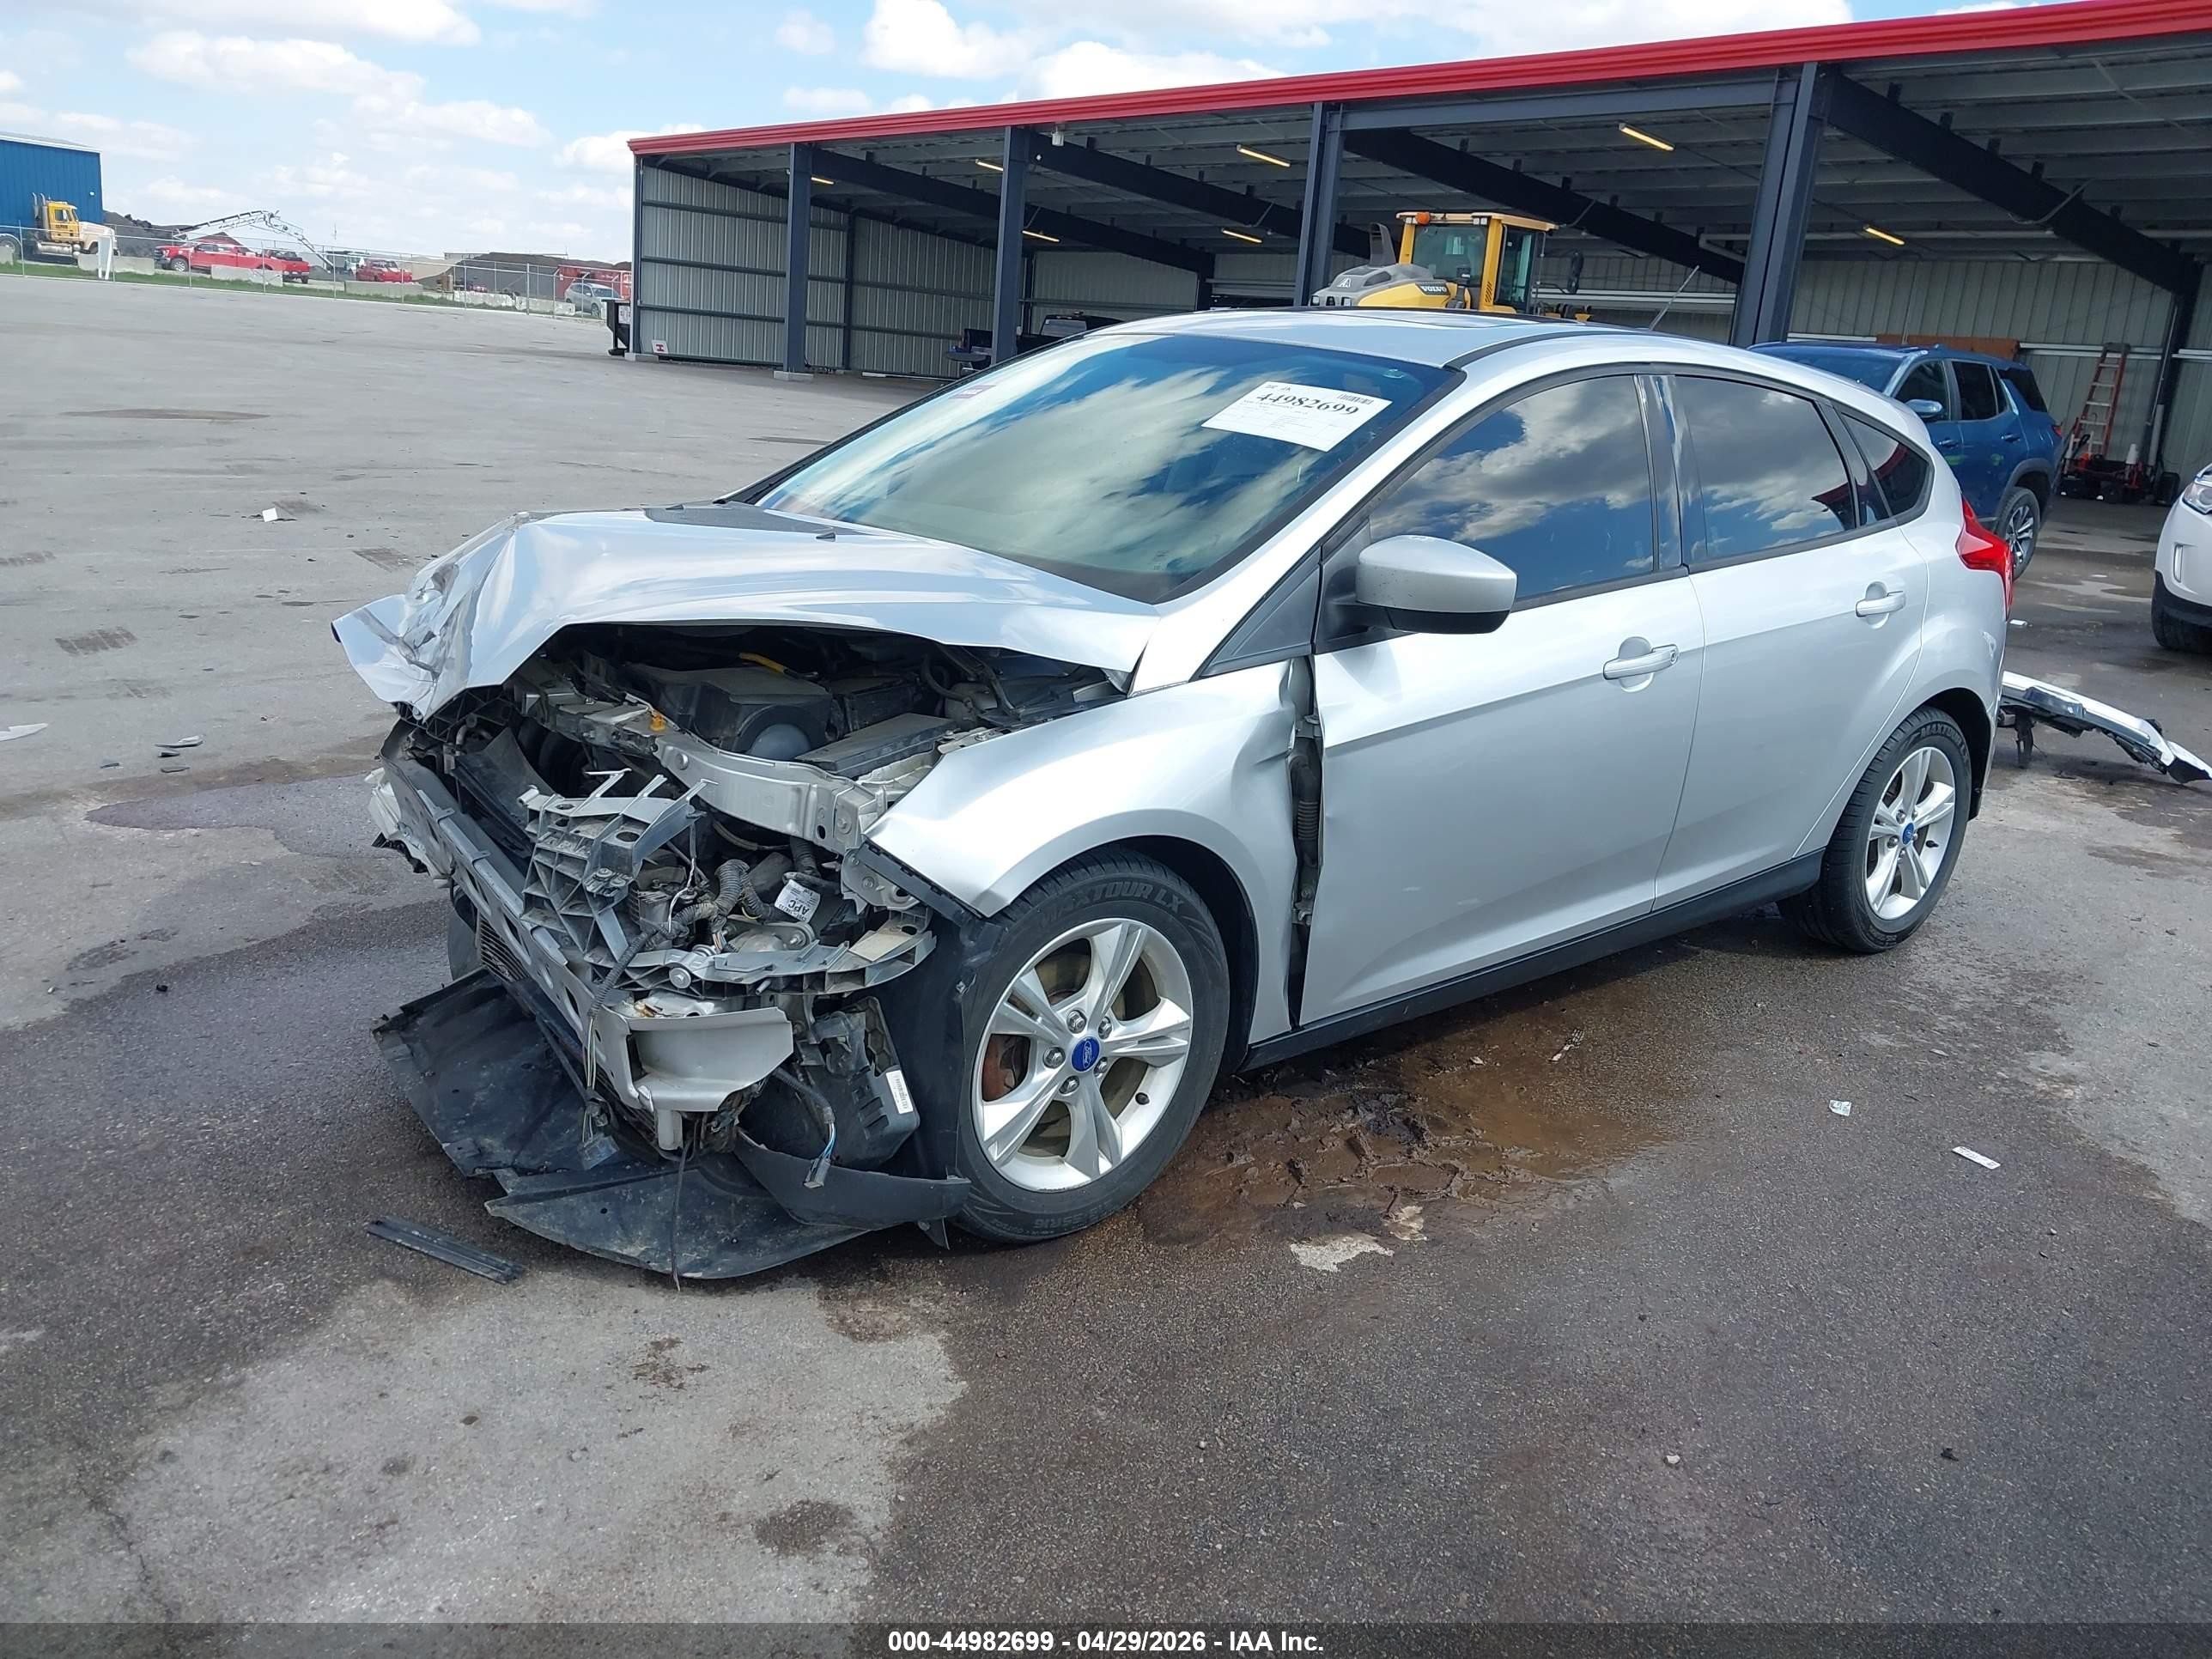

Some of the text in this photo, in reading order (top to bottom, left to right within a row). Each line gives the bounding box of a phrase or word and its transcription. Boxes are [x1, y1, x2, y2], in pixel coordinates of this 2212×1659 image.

[1256, 392, 1359, 416] 44982699
[787, 899, 810, 915] APC
[1154, 889, 1185, 914] LX
